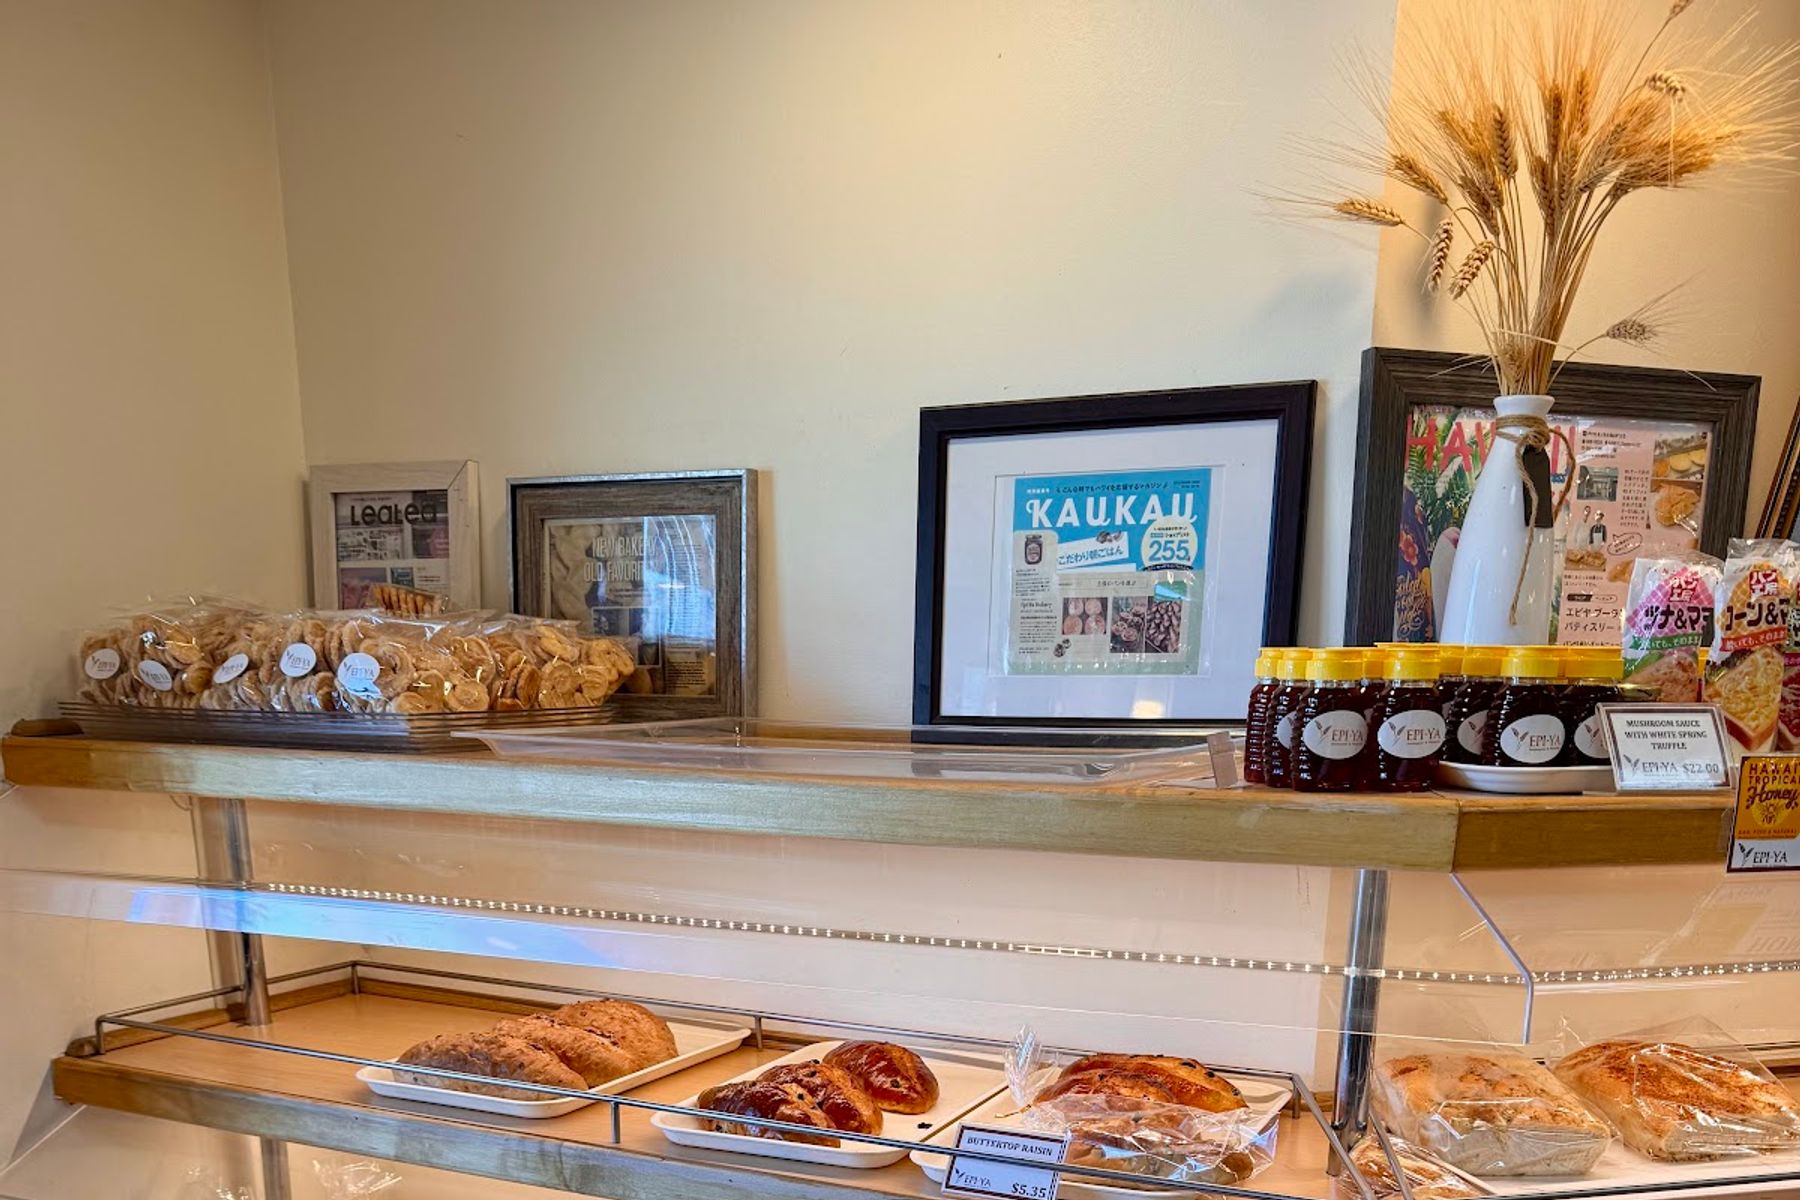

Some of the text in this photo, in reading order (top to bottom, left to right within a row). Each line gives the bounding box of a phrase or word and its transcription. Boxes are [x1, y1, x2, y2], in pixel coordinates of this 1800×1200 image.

[1404, 413, 1576, 475] HAII
[1026, 493, 1198, 528] KAUKAU
[592, 535, 657, 558] NEW BAKEY
[1148, 540, 1189, 562] 255
[584, 561, 603, 582] OLD
[1626, 719, 1701, 728] MUSHROOM SAUCE
[1331, 729, 1364, 742] EPI-YA
[1406, 728, 1441, 741] EPI-YA
[1529, 735, 1561, 747] EPI-YA
[1625, 731, 1707, 739] WITH WHITE SPRING
[1651, 742, 1688, 750] TRUFFLE
[1642, 762, 1720, 774] EPI-YA $22.00
[1749, 763, 1800, 775] HAWAI
[1749, 775, 1800, 785] TROPICA
[1746, 783, 1799, 810] Honey
[1753, 850, 1788, 864] EPI-YA
[967, 1137, 1053, 1156] BUTTERTOP RAISIN
[964, 1175, 992, 1187] EPI-YA
[1011, 1182, 1047, 1198] $5.35
